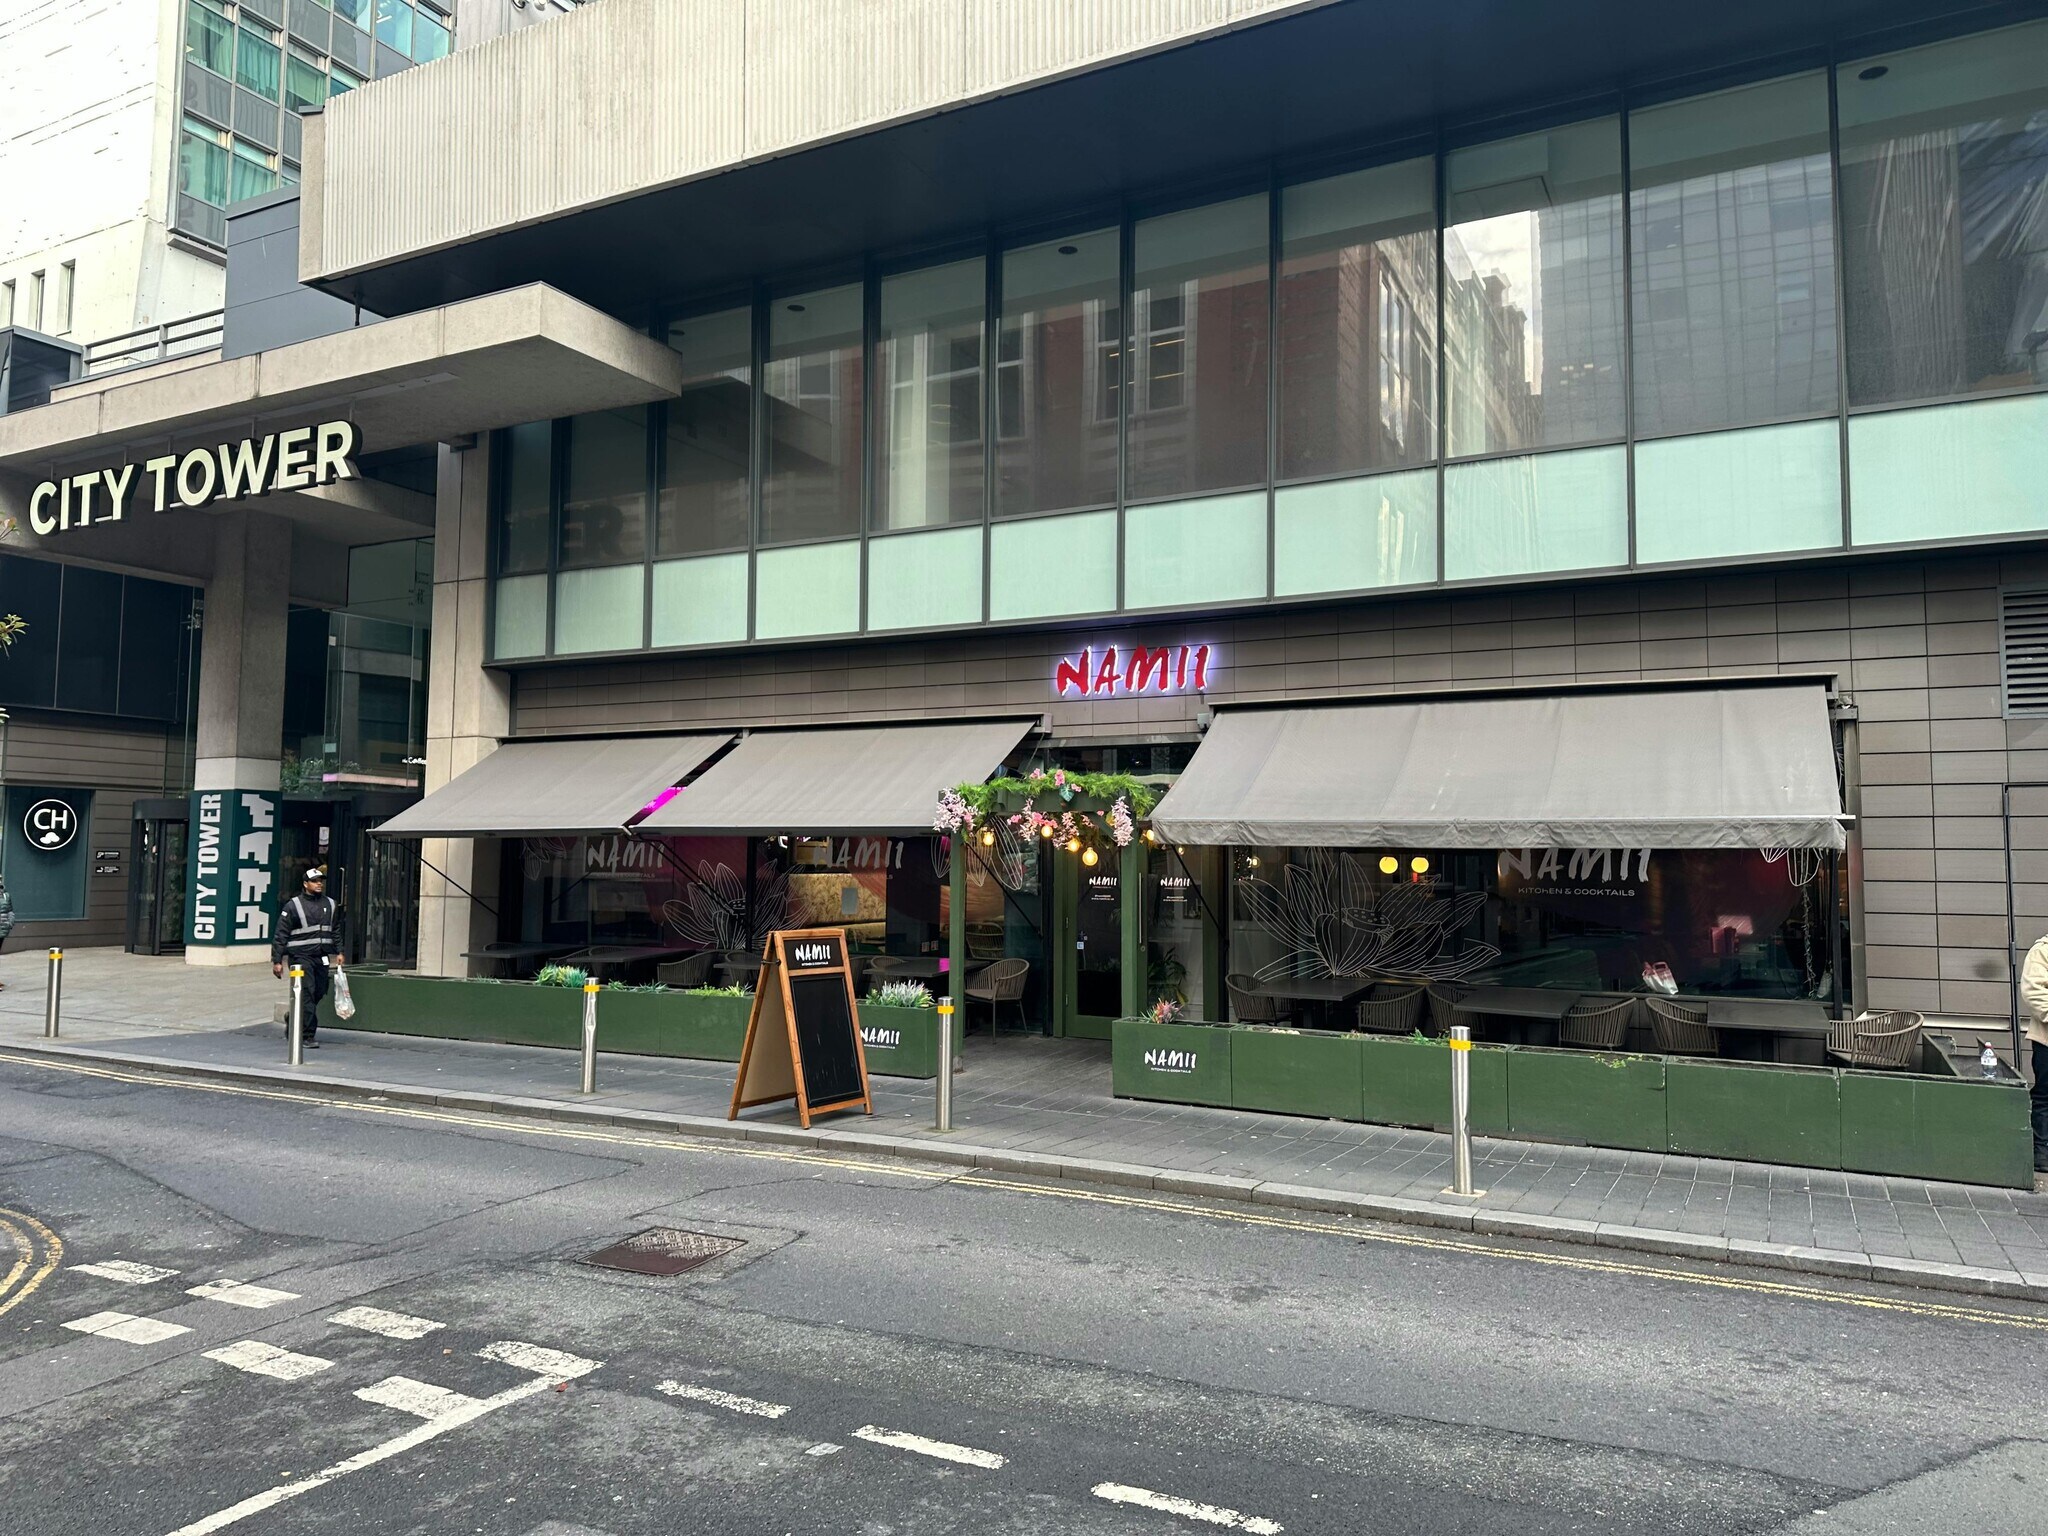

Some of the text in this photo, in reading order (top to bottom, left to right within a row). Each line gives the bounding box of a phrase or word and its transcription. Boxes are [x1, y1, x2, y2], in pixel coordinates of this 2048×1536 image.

[29, 420, 355, 536] CITY TOWER
[1056, 643, 1211, 697] NAMII
[33, 808, 68, 830] CH
[587, 836, 665, 873] NAMII
[193, 793, 222, 940] CITY TOWER
[1089, 876, 1118, 886] NAMII
[1160, 877, 1191, 887] NAMII
[795, 944, 831, 961] NAMII
[1144, 1048, 1197, 1069] NAMII
